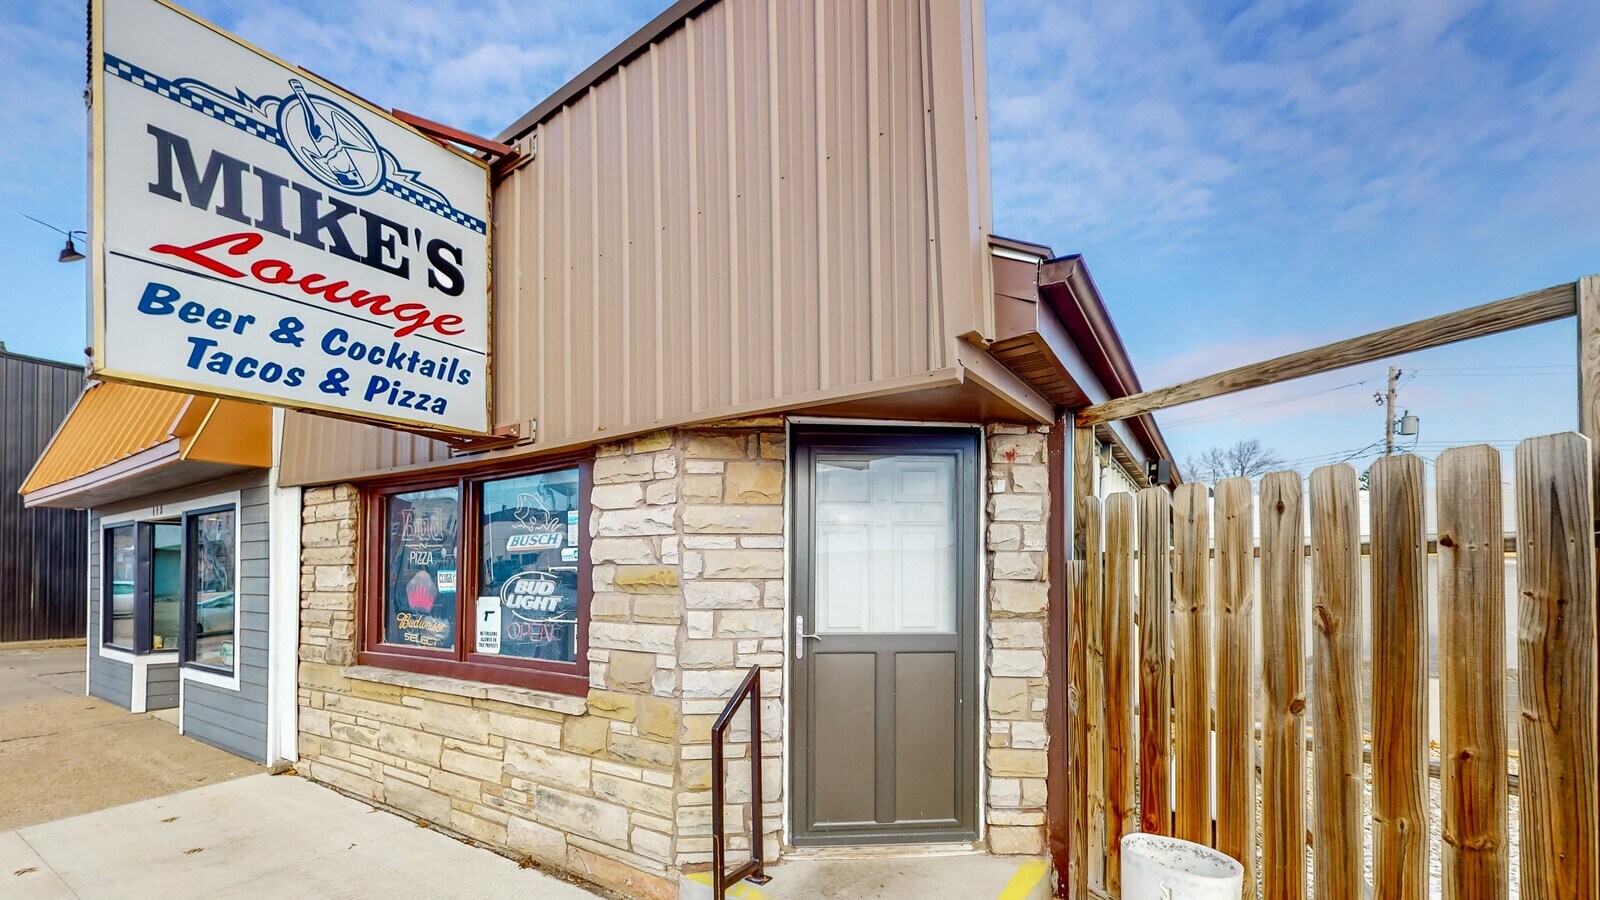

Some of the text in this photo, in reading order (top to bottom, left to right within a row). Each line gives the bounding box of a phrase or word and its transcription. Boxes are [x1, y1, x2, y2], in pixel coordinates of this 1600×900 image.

[147, 124, 465, 297] MIKE'S
[149, 232, 466, 338] Lounge
[137, 282, 472, 386] Beer & Cocktails
[187, 336, 448, 416] Tacos & Pizza
[401, 507, 444, 541] Bud
[510, 533, 560, 547] BUSCH
[409, 550, 434, 565] PIZZA
[514, 580, 556, 595] BUD
[506, 593, 562, 611] LIGHT
[404, 632, 441, 647] SELECT
[507, 621, 554, 642] OPEN
